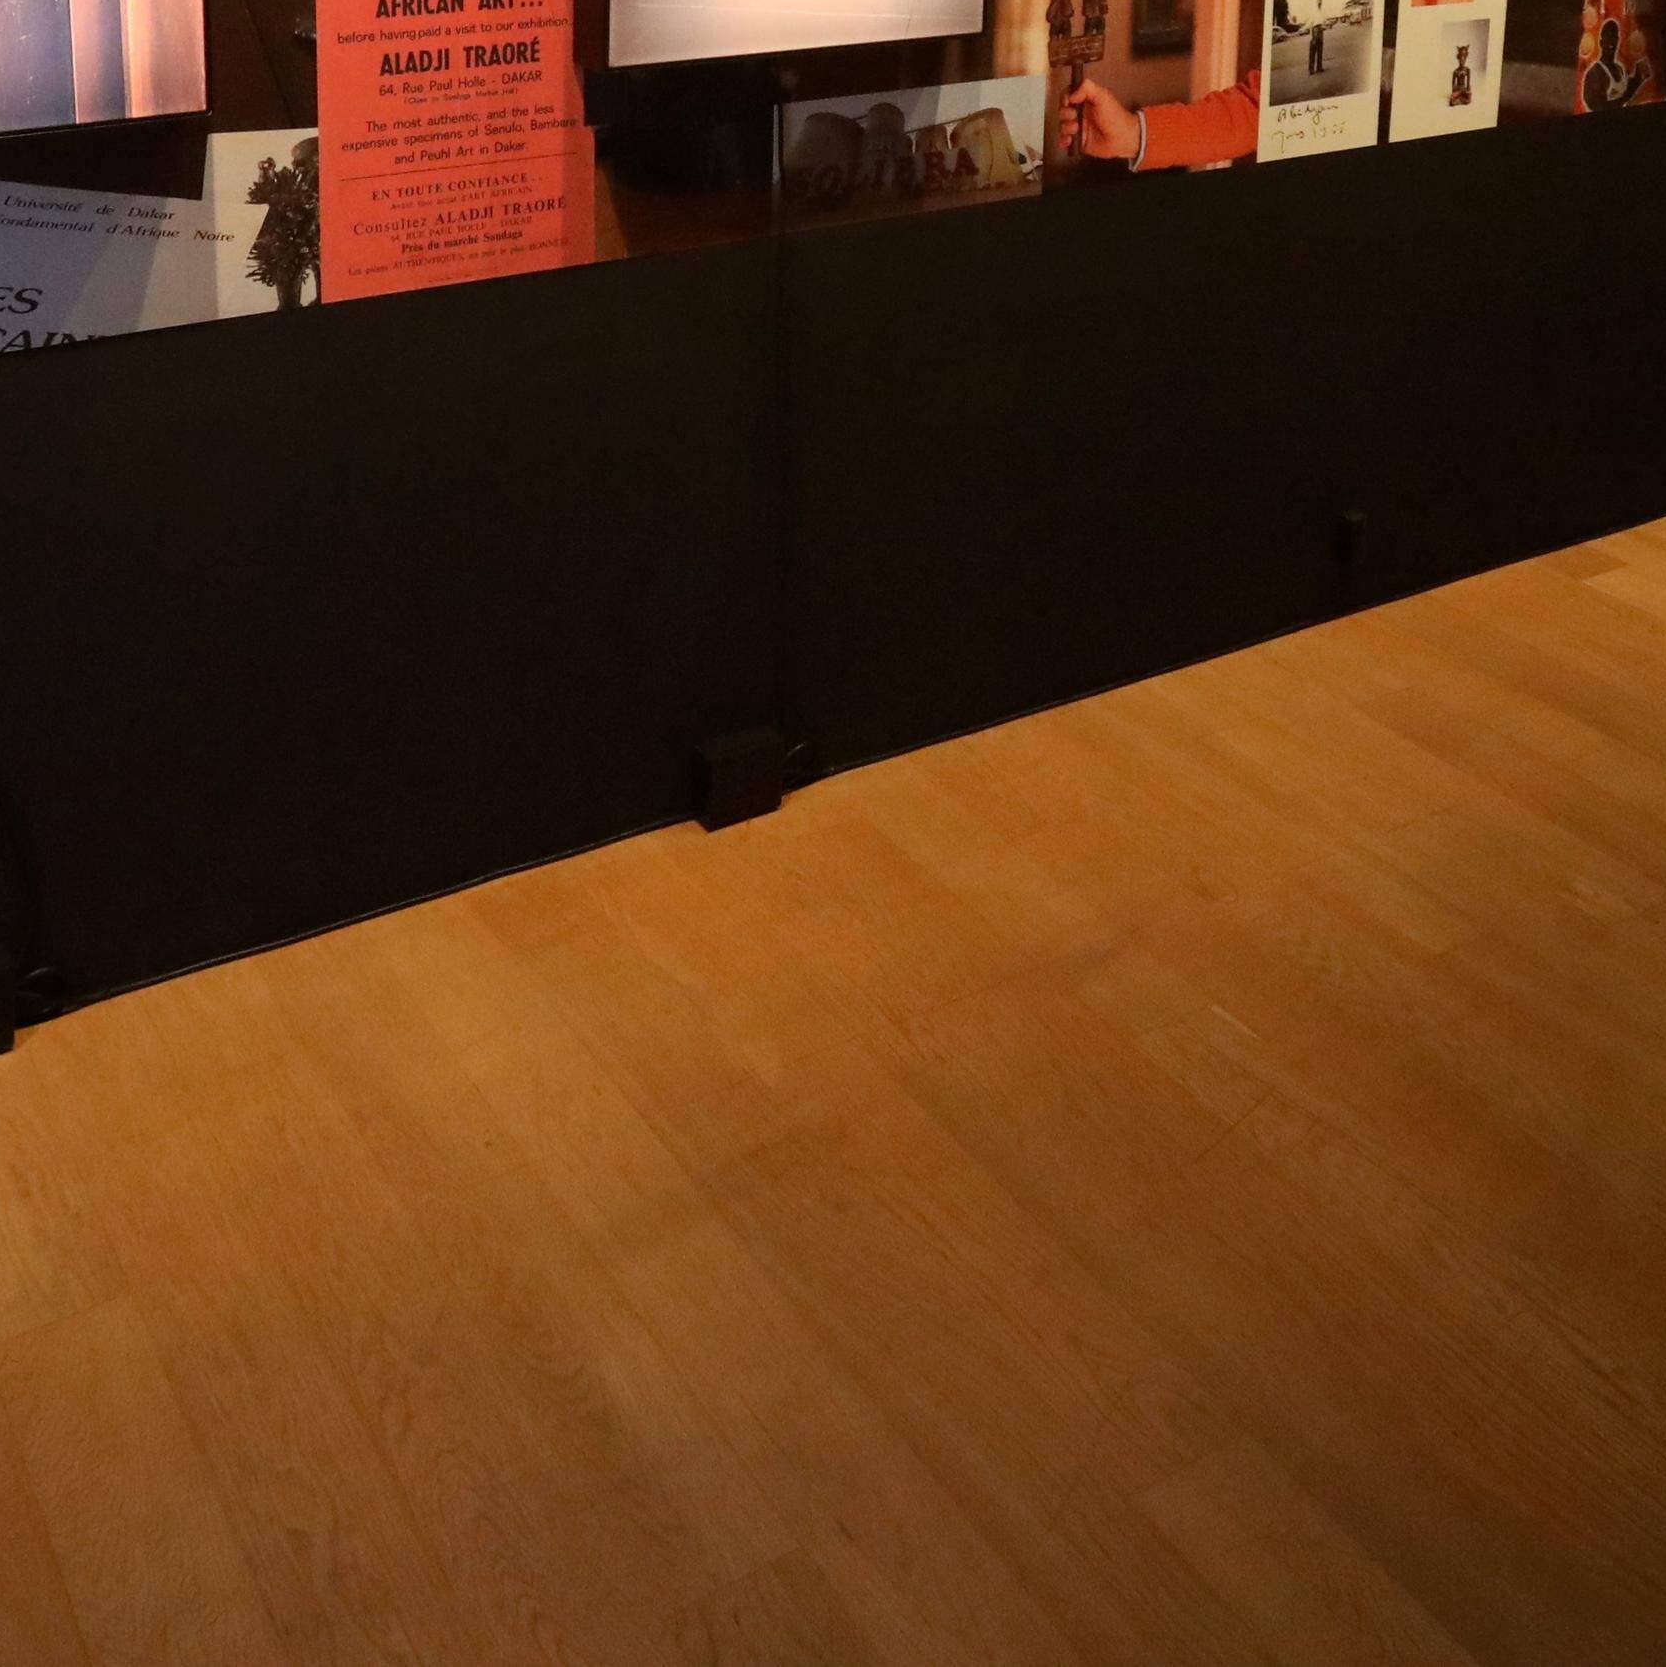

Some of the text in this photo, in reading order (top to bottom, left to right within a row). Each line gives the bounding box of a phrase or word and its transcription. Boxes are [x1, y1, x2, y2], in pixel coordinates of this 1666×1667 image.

[337, 31, 375, 45] before
[379, 28, 416, 43] having
[417, 26, 442, 40] paid
[455, 21, 476, 35] visit
[480, 22, 492, 33] to
[495, 21, 514, 32] our
[379, 36, 541, 77] ALADJI TRAORÉ
[402, 80, 424, 94] Rue
[429, 77, 453, 92] Paul
[457, 75, 486, 89] Holle
[501, 69, 543, 85] DAKAR
[366, 119, 388, 134] The
[393, 116, 422, 131] most
[486, 107, 507, 121] and
[511, 105, 529, 118] the
[534, 103, 555, 116] less
[341, 136, 398, 153] expensive
[403, 130, 463, 147] specimens
[467, 125, 480, 138] of
[394, 150, 415, 166] and
[420, 146, 451, 162] Peuhl
[455, 144, 475, 157] Art
[479, 142, 490, 155] in
[371, 188, 391, 202] EN
[397, 183, 444, 200] TOUTE
[4, 195, 176, 221] Université de Dakar
[353, 216, 428, 235] Consultez
[434, 206, 494, 226] ALADJI
[106, 223, 181, 240] d'Afrique
[193, 229, 236, 243] Noire
[427, 239, 440, 251] du
